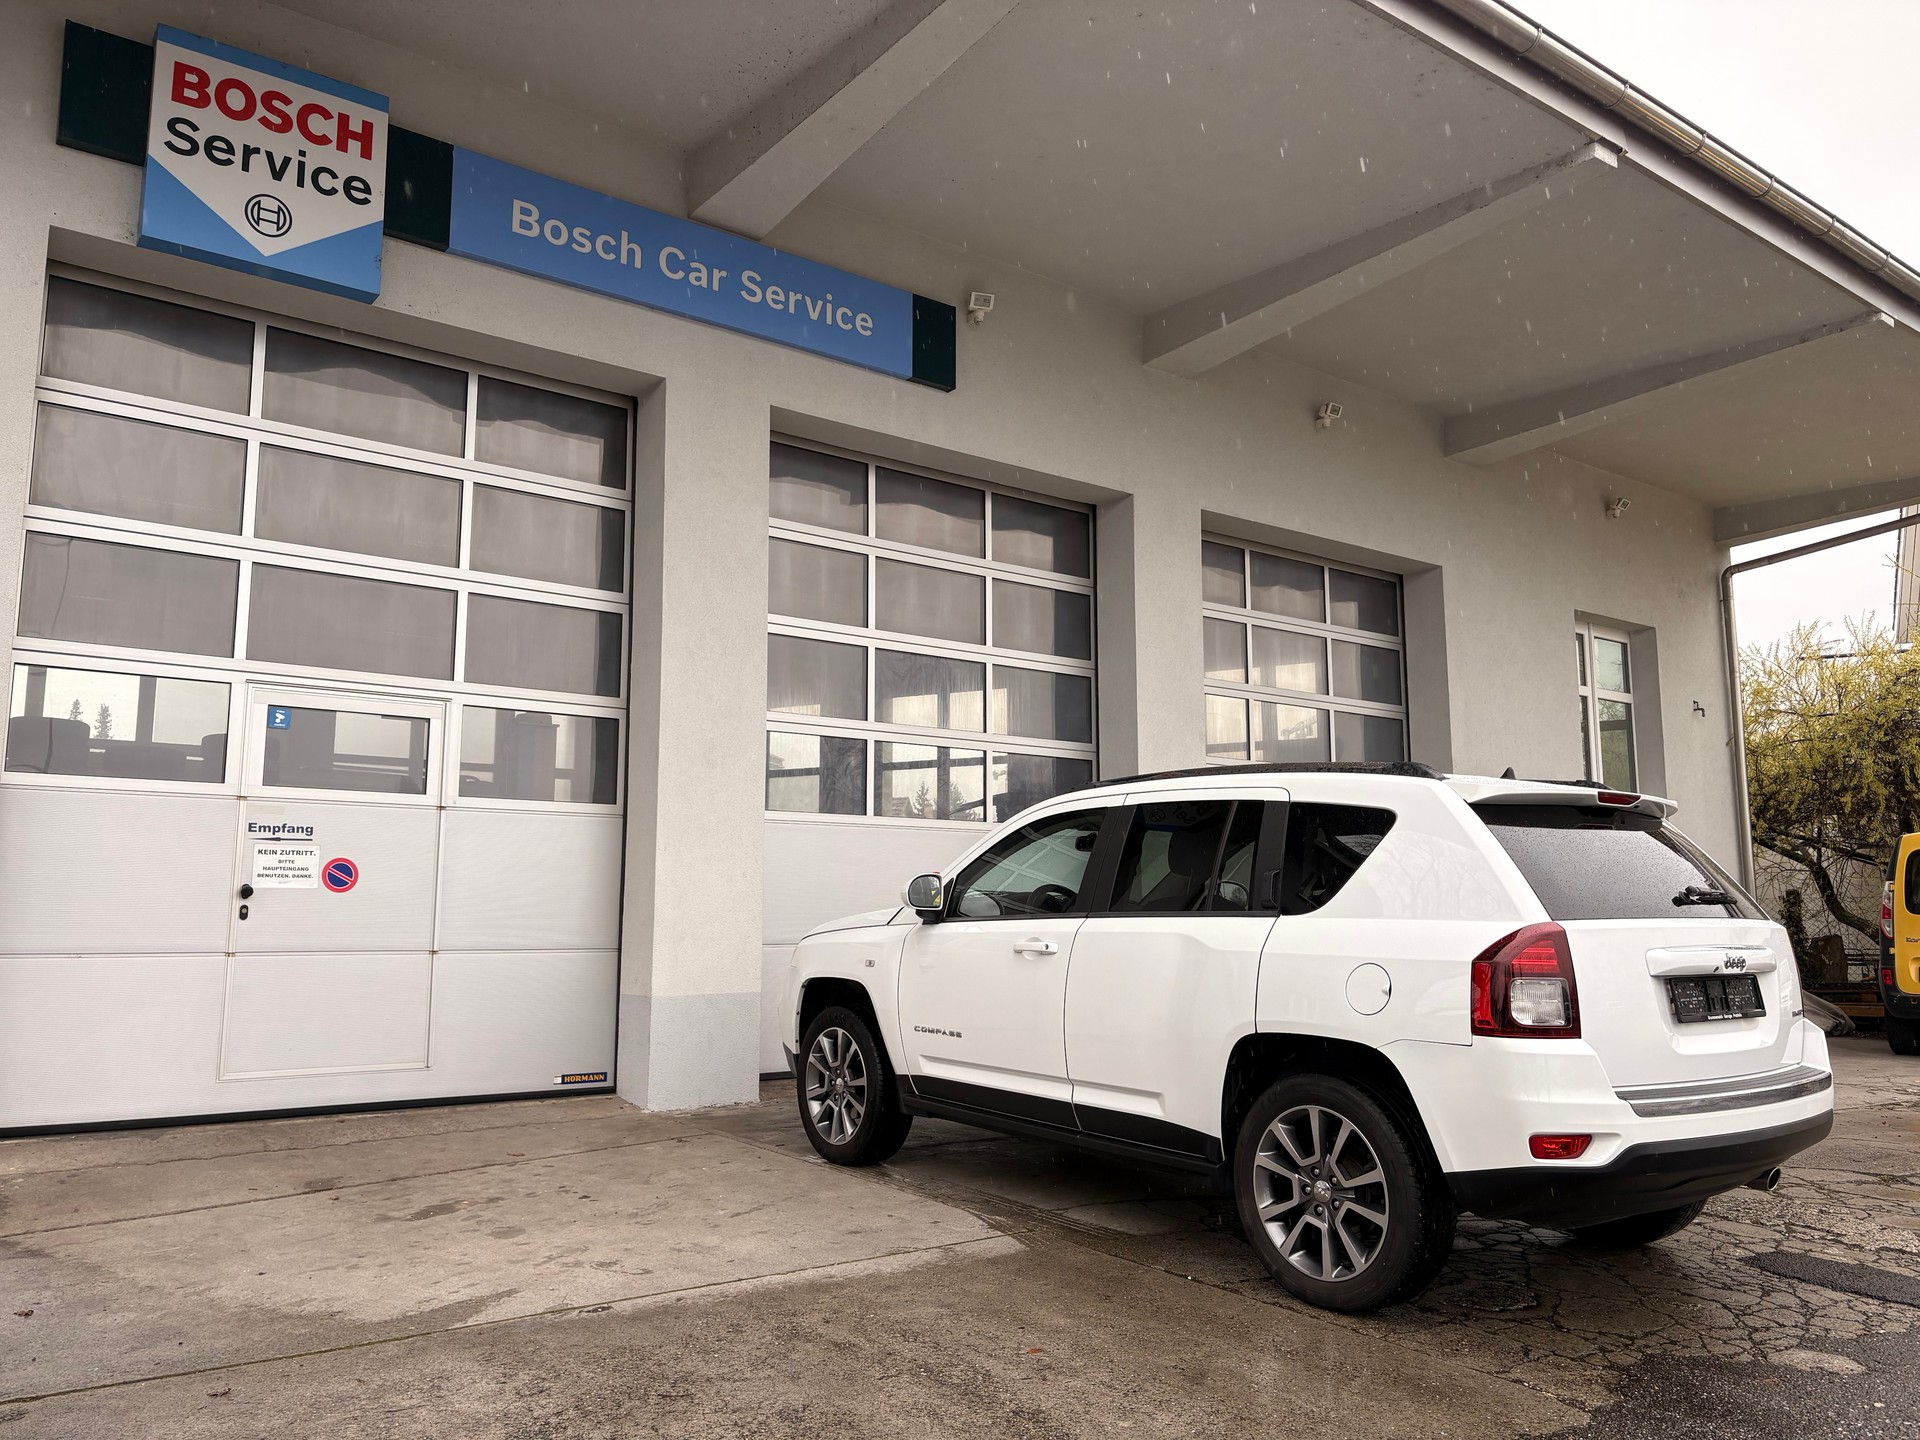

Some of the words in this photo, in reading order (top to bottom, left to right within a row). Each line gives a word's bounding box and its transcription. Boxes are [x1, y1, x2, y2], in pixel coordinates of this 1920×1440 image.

[171, 60, 374, 161] BOSCH
[163, 116, 373, 206] Service
[511, 198, 642, 269] Bosch
[658, 246, 728, 292] Car
[740, 270, 874, 336] Service
[247, 822, 314, 836] Empfang
[279, 849, 316, 857] ZUTRITT.
[1723, 956, 1747, 972] Jeep
[914, 1025, 962, 1039] COMPASS
